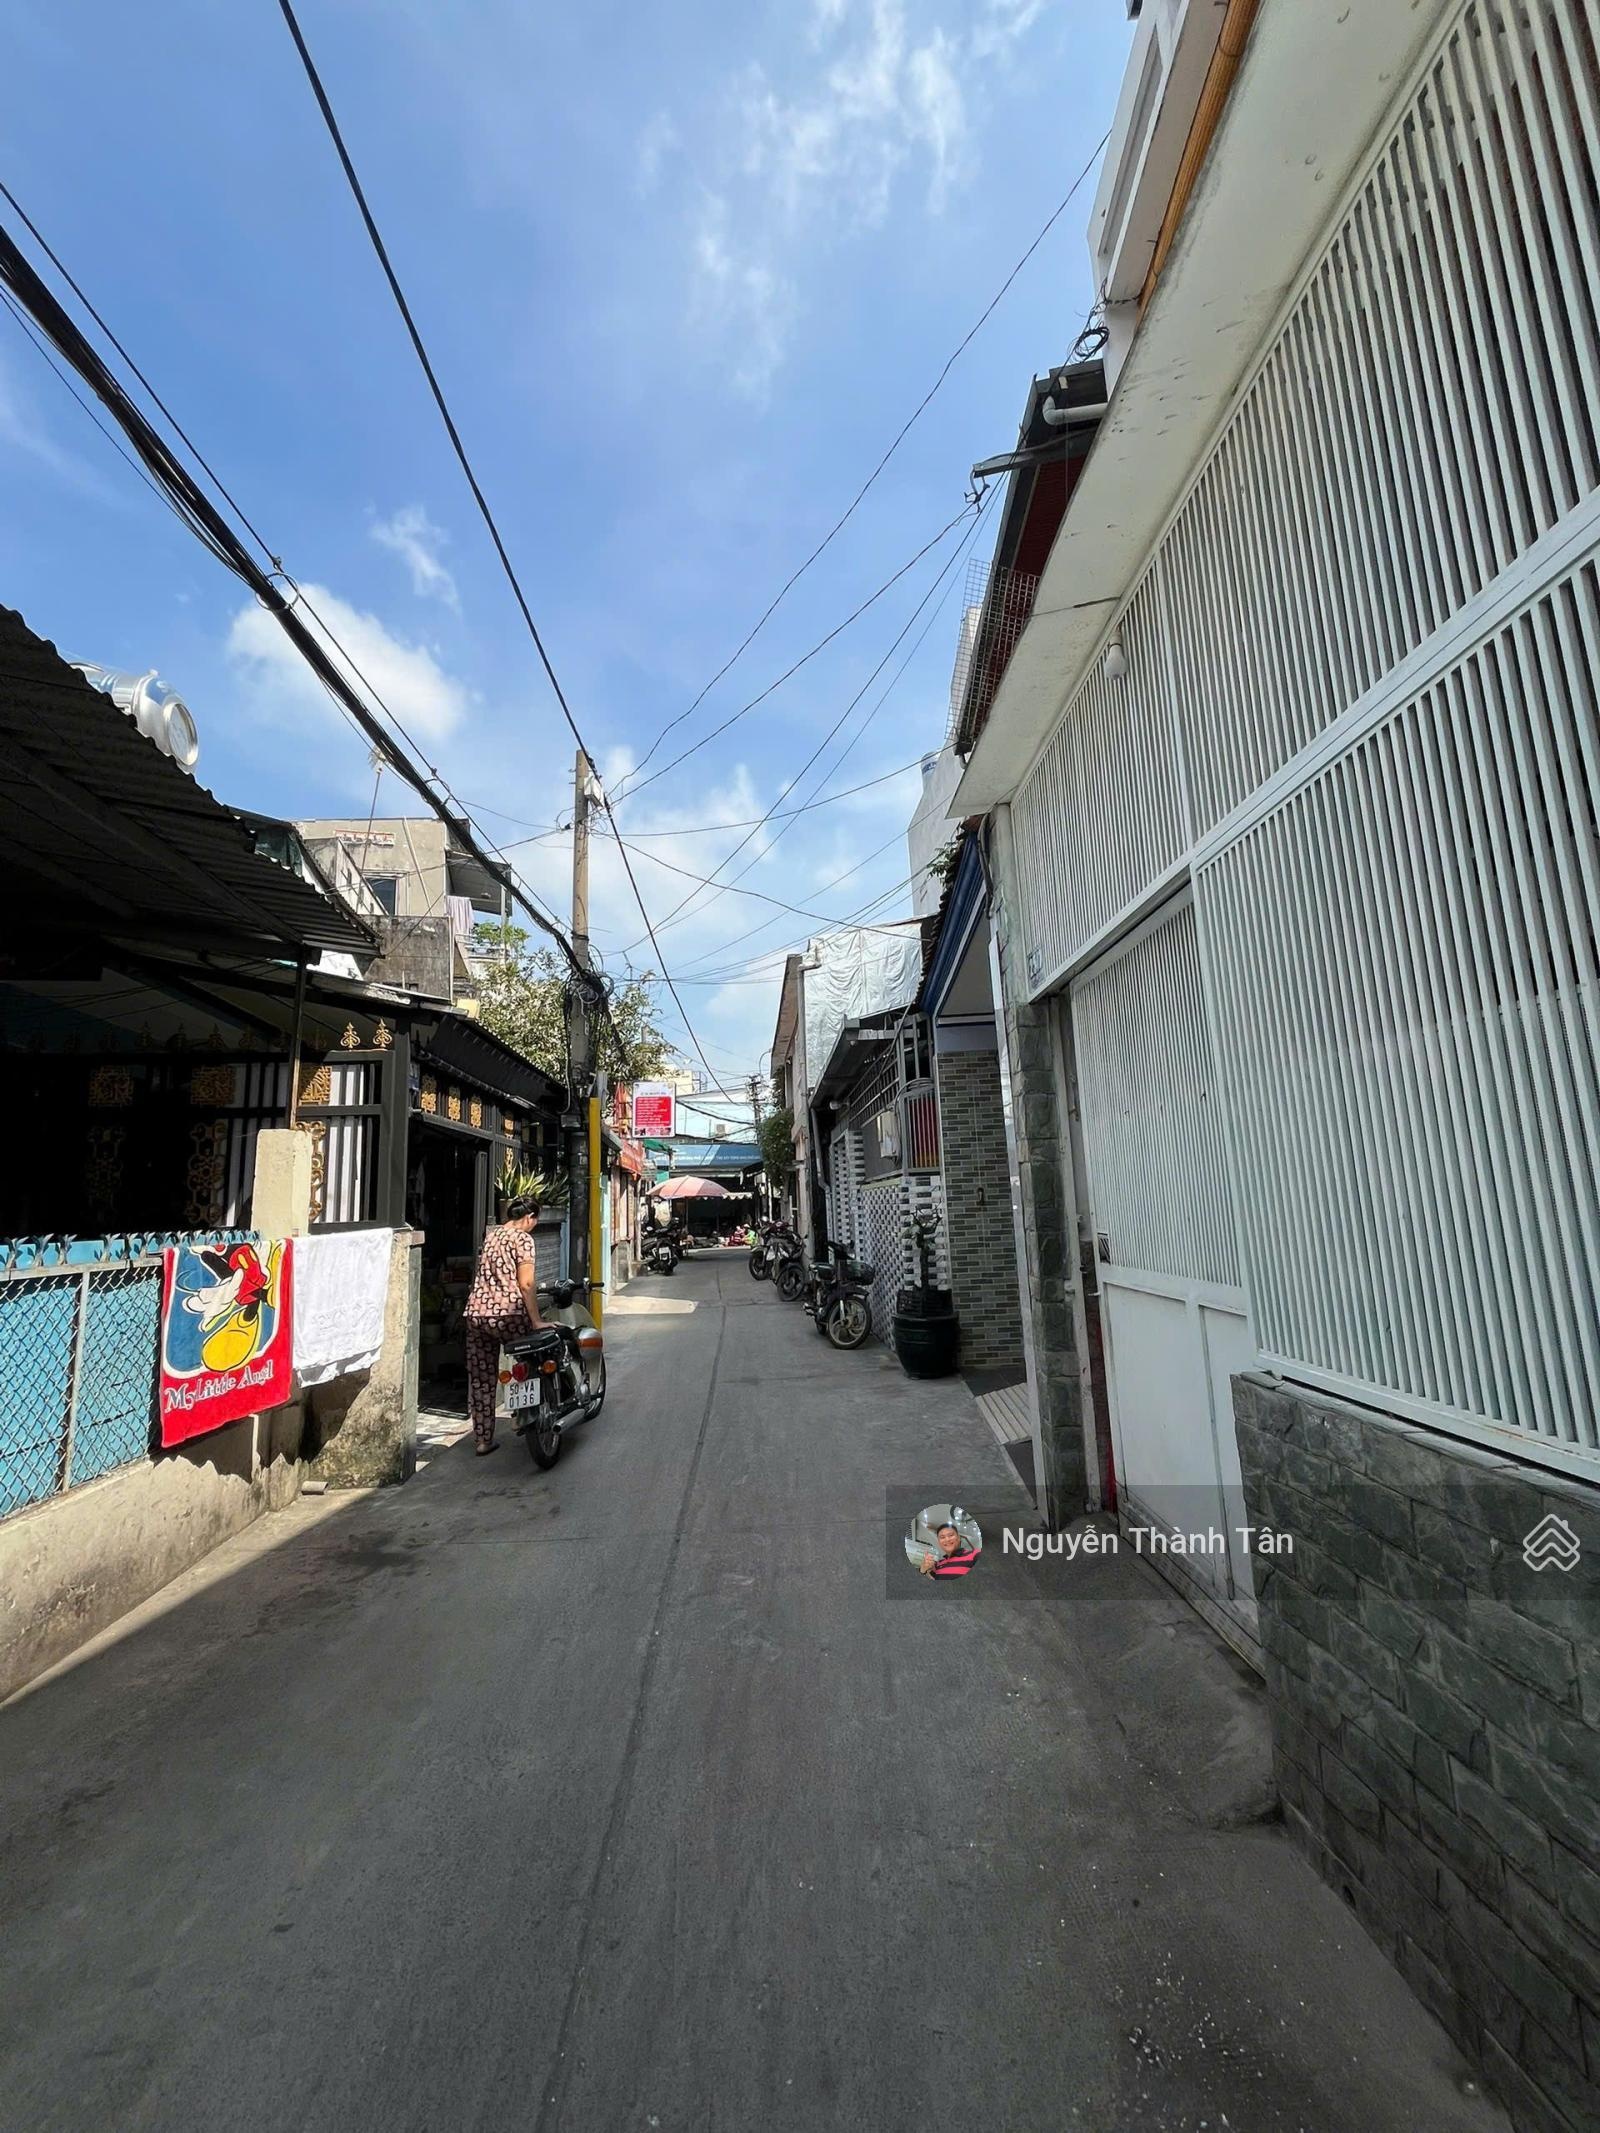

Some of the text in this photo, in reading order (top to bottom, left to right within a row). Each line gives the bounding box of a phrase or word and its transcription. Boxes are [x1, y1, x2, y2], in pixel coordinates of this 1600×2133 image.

[164, 1383, 194, 1413] My
[195, 1373, 237, 1402] Little
[509, 1394, 535, 1409] 0136
